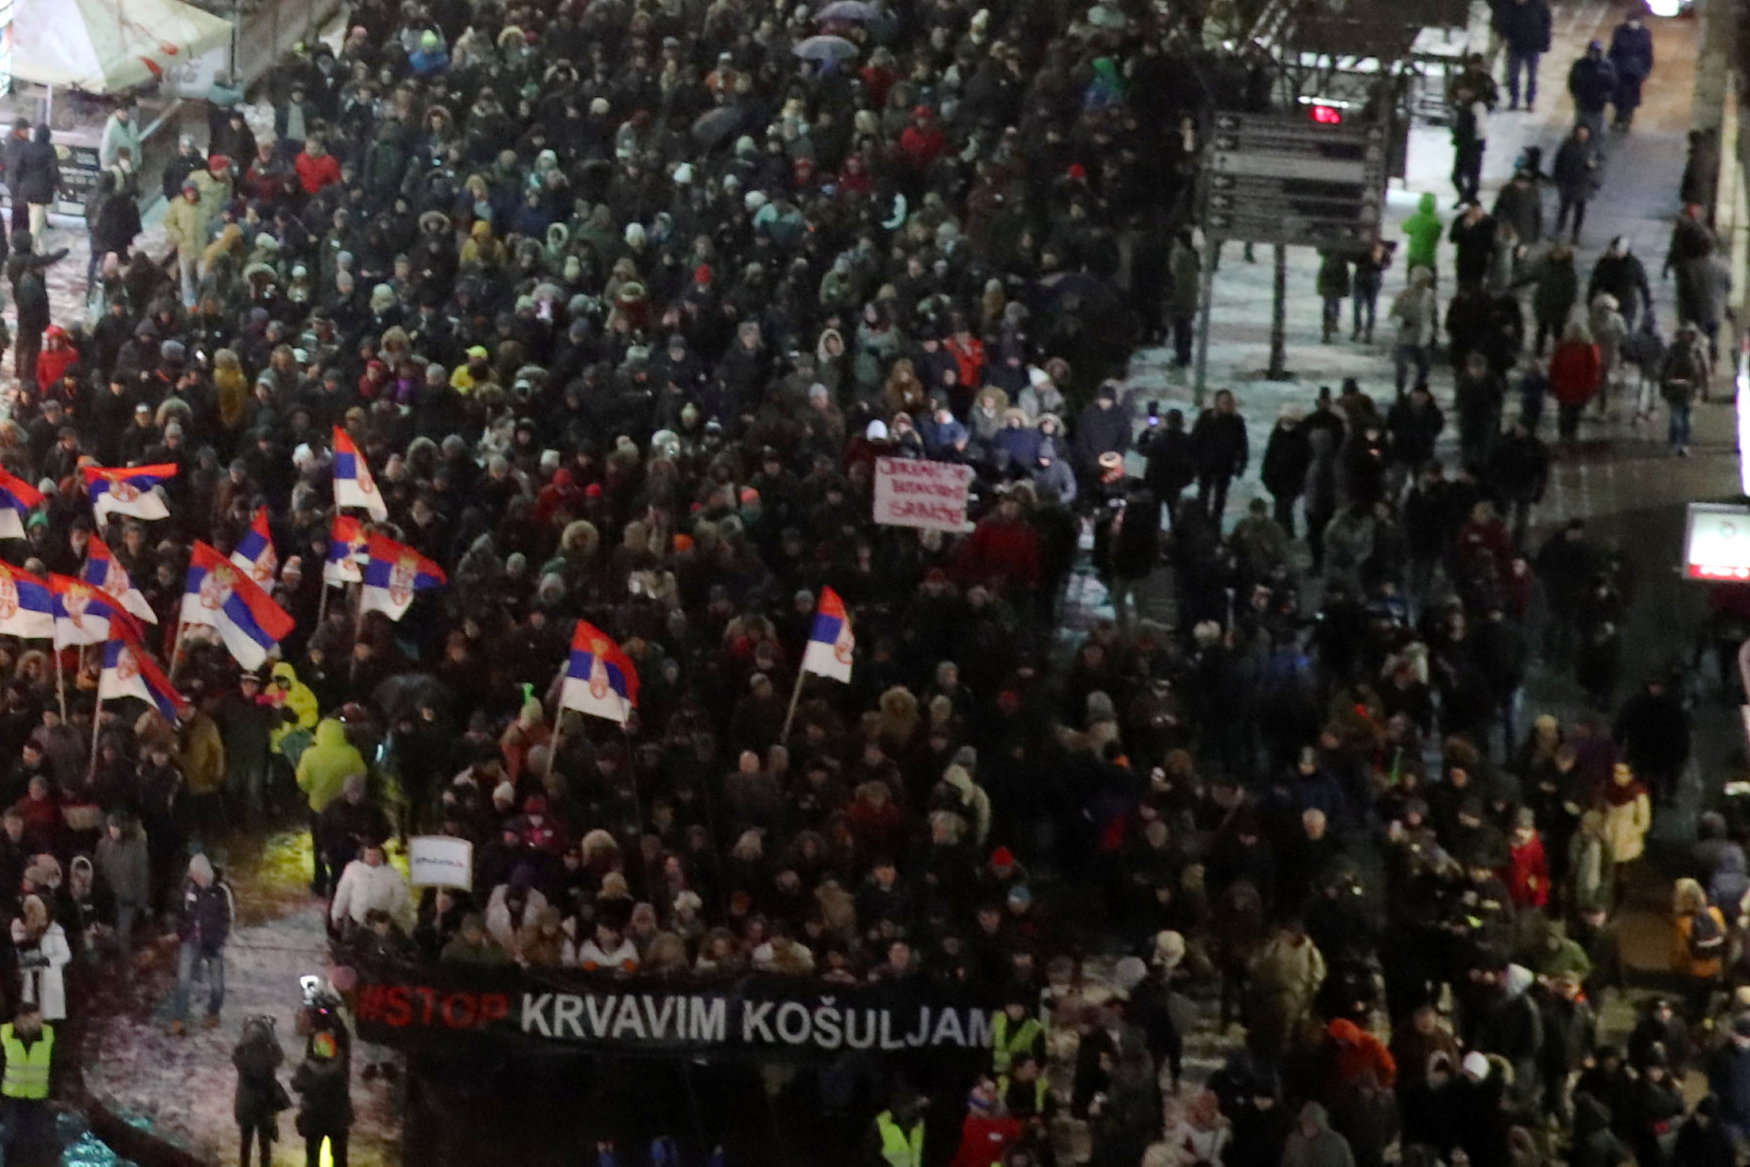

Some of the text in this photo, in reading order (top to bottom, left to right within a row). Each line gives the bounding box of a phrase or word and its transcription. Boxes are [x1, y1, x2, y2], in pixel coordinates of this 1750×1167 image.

[357, 984, 998, 1050] #STOP KRVAVIM KOŠULJAM
